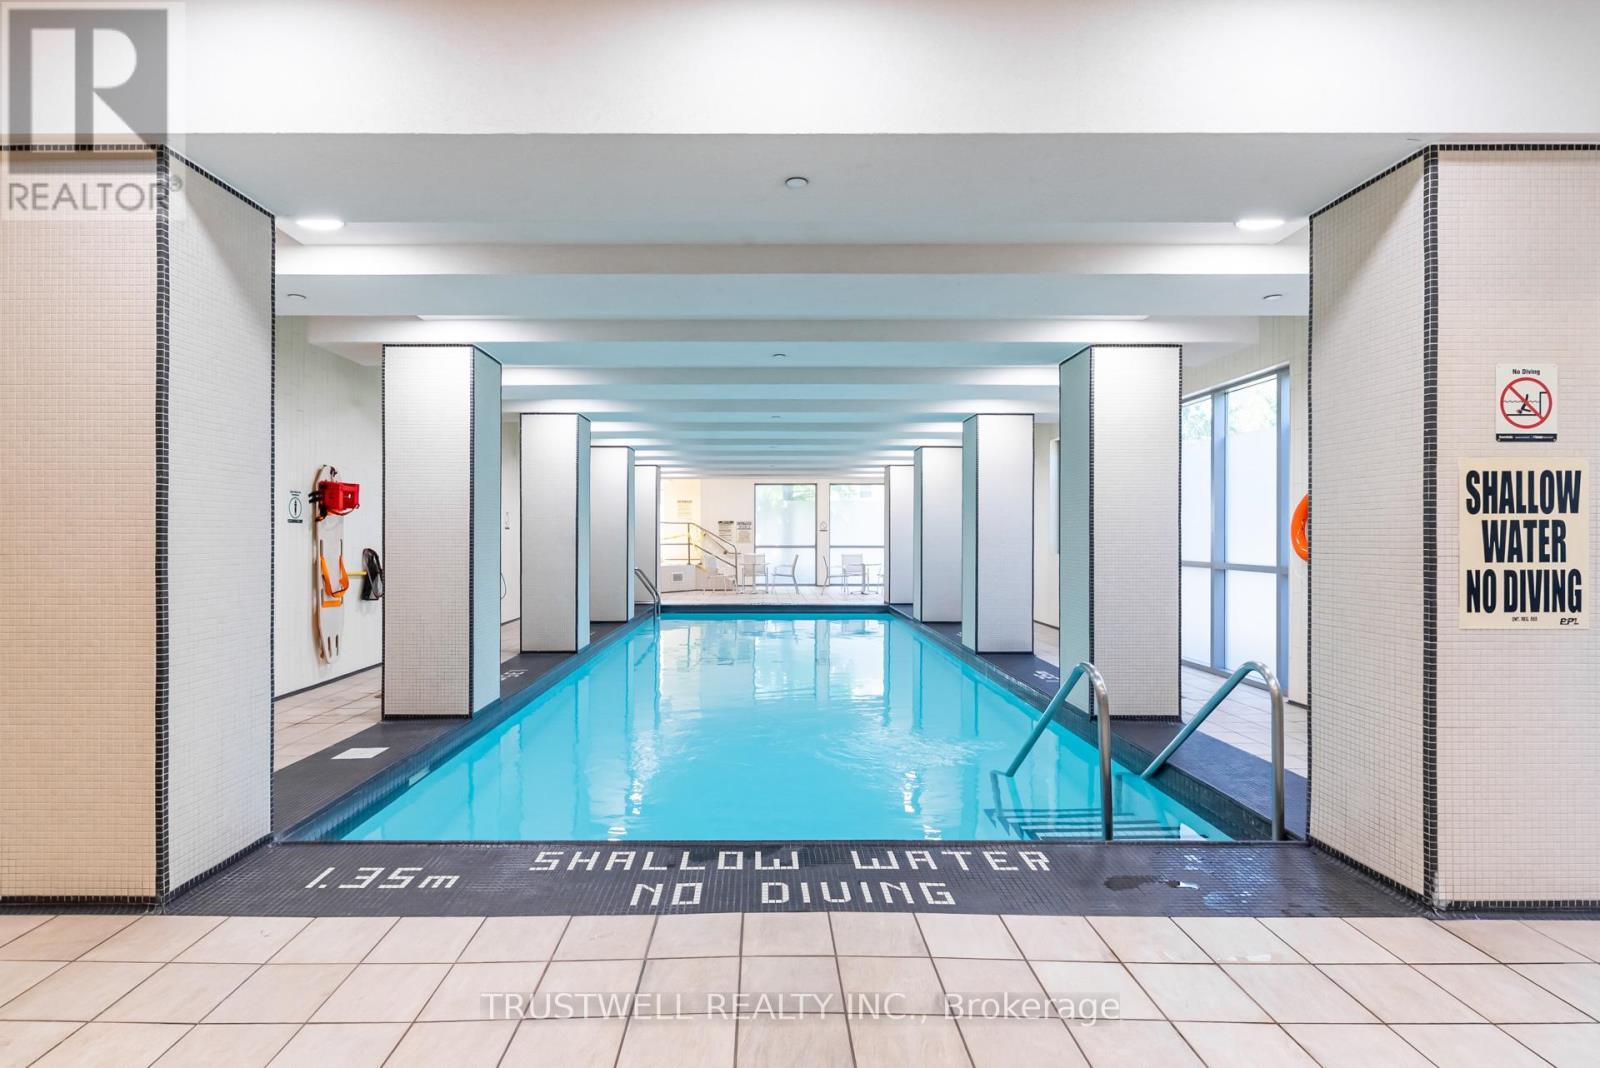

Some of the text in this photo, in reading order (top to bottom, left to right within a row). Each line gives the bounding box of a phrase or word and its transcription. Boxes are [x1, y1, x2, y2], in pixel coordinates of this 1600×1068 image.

[1466, 470, 1582, 515] SHALLOW
[1482, 519, 1567, 563] WATER
[1466, 569, 1582, 614] NO DIVING
[529, 851, 1051, 871] SHALLOW WATER
[629, 882, 955, 906] NO DIVING
